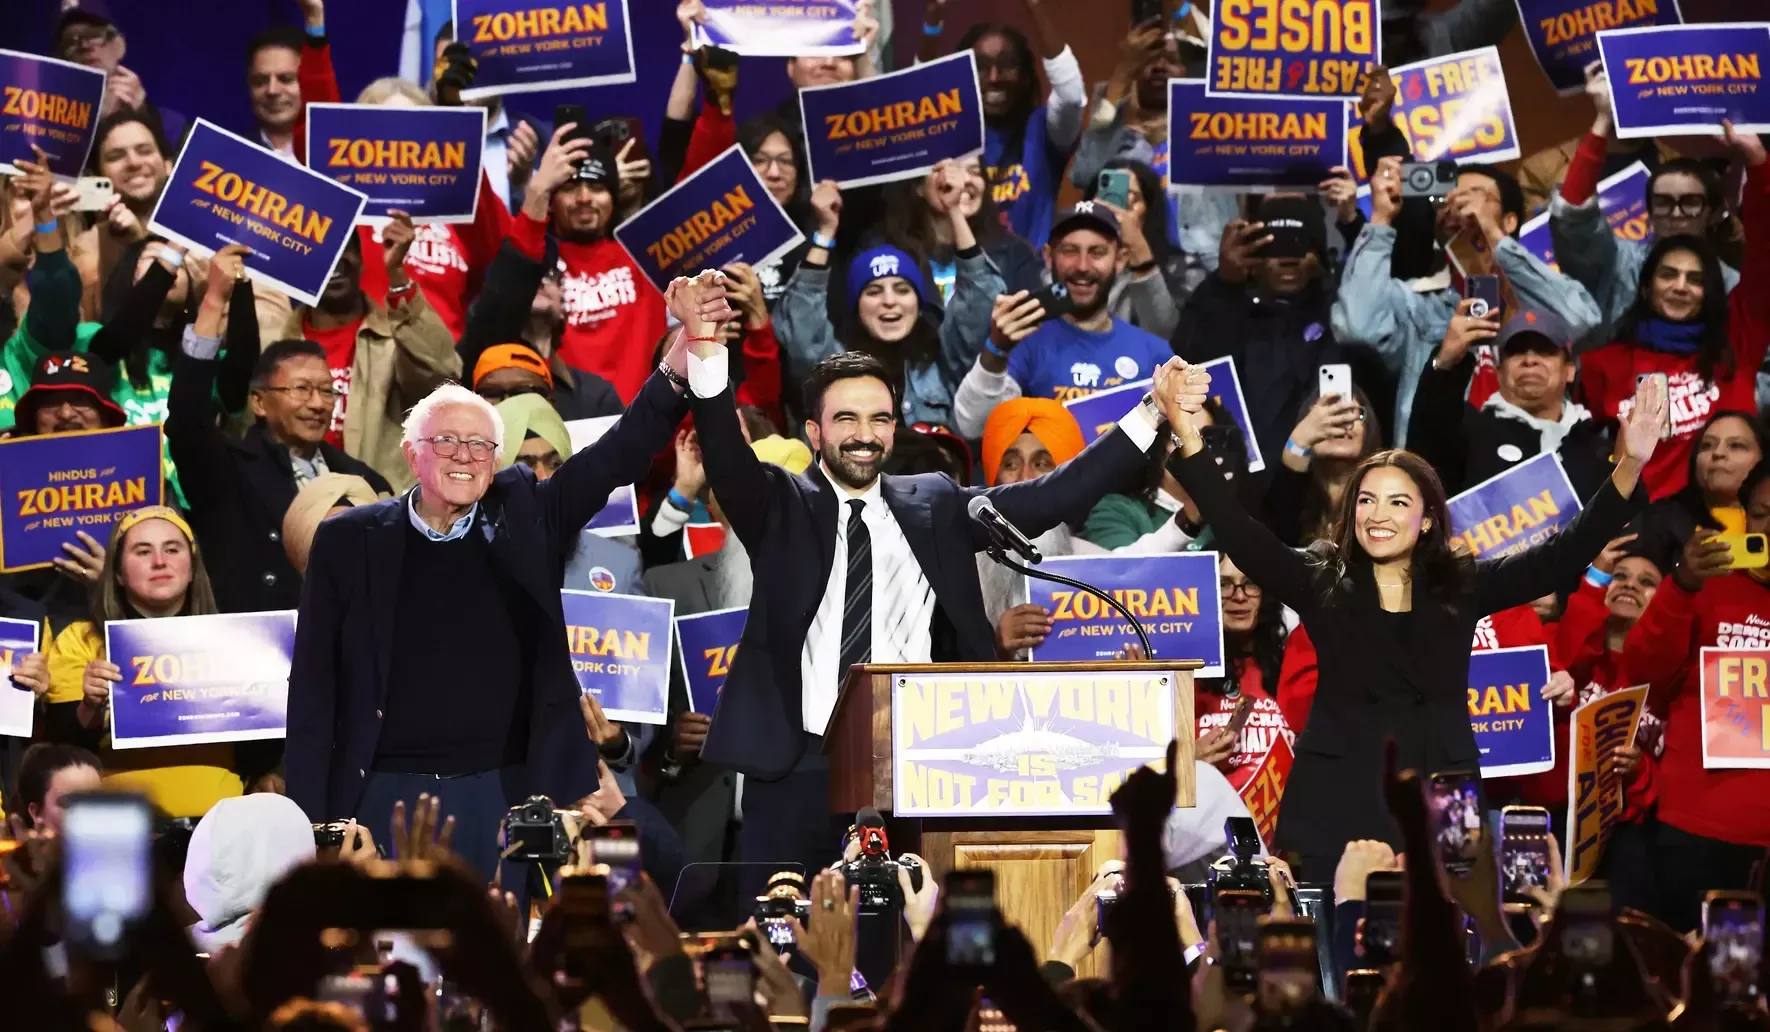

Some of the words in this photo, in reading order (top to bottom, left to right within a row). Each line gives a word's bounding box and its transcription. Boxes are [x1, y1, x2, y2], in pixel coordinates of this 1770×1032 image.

[472, 2, 609, 43] ZOHRAN
[1219, 0, 1373, 55] BUSES
[1540, 0, 1659, 47] ZOHRAN
[500, 42, 531, 56] NEW
[534, 39, 571, 53] YORK
[572, 35, 603, 49] CITY
[1216, 55, 1283, 92] FREE
[1303, 59, 1373, 95] FAST
[1424, 55, 1492, 98] FREE
[1624, 52, 1763, 85] ZOHRAN
[2, 85, 93, 130] ZOHRAN
[1657, 85, 1689, 98] NEW
[1691, 84, 1726, 96] YORK
[1728, 83, 1758, 95] CITY
[824, 88, 963, 141] ZOHRAN
[1189, 112, 1328, 141] ZOHRAN
[855, 135, 888, 151] NEW
[890, 130, 926, 145] YORK
[928, 120, 958, 137] CITY
[1215, 144, 1248, 156] NEW
[1250, 144, 1286, 156] YORK
[1288, 144, 1321, 157] CITY
[328, 138, 467, 170] ZOHRAN
[355, 172, 389, 185] NEW
[391, 173, 427, 185] YORK
[428, 174, 458, 186] CITY
[192, 159, 334, 245] ZOHRAN
[212, 203, 246, 226] NEW
[246, 219, 282, 245] YORK
[281, 234, 313, 256] CITY
[646, 184, 756, 273] ZOHRAN
[731, 214, 758, 238] CITY
[48, 467, 97, 483] HINDUS
[17, 476, 147, 518] ZOHRAN
[42, 515, 74, 529] NEW
[76, 513, 113, 526] YORK
[1449, 488, 1561, 560] HRAN
[1529, 522, 1560, 546] CITY
[1050, 586, 1200, 621] ZOHRAN
[565, 624, 651, 661] RAN
[1080, 624, 1116, 637] NEW
[1118, 623, 1157, 636] YORK
[1159, 621, 1194, 635] CITY
[606, 661, 642, 678] CITY
[162, 688, 197, 702] NEW
[1467, 682, 1531, 718] RAN
[905, 679, 1021, 750] NEW
[1021, 679, 1160, 748] YORK
[1472, 721, 1490, 734] RK
[1491, 717, 1525, 734] CITY
[1725, 702, 1754, 738] THE
[1017, 754, 1057, 776] IS
[903, 760, 977, 809] NOT
[987, 776, 1062, 808] FOR
[1243, 755, 1285, 828] EZE
[1573, 770, 1599, 873] ALL
